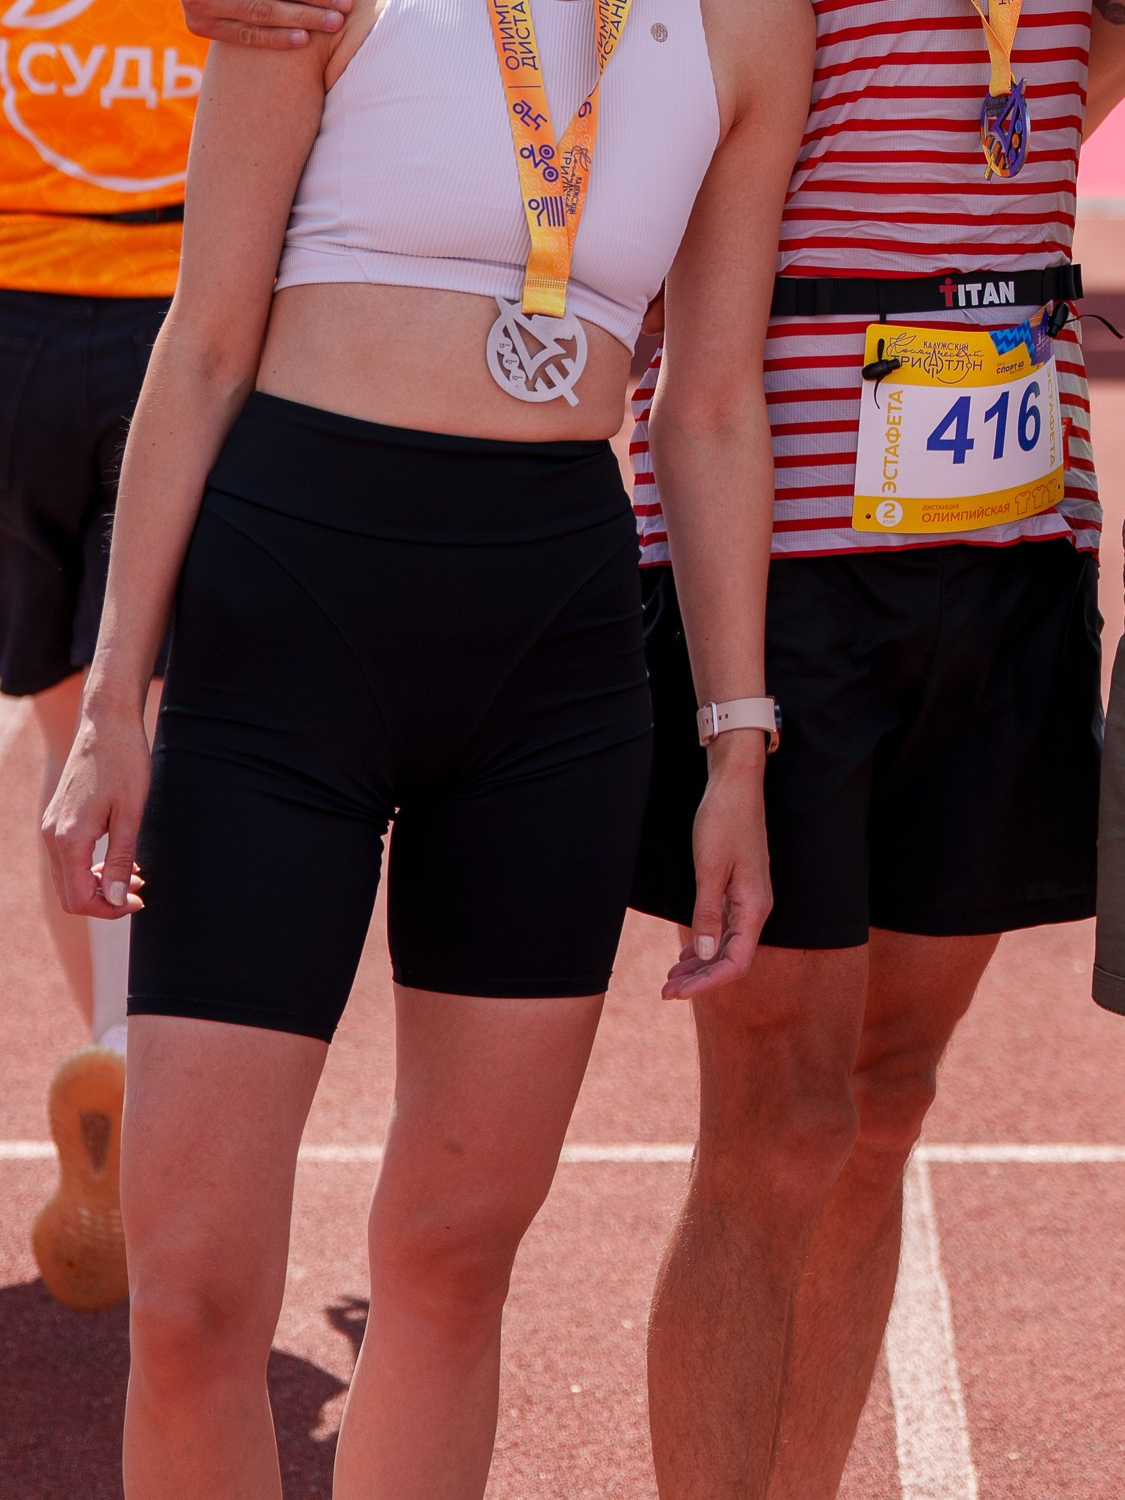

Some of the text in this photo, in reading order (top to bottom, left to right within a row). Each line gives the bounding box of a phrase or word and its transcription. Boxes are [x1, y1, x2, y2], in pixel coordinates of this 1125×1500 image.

[18, 41, 204, 110] СУДЬ
[881, 389, 904, 493] ЭСТАФЕТА
[926, 381, 1041, 465] 416
[882, 503, 896, 519] 2
[921, 504, 960, 512] ДИСТАНЦИЯ
[921, 502, 1011, 523] ОЛИМПИЙСКАЯ
